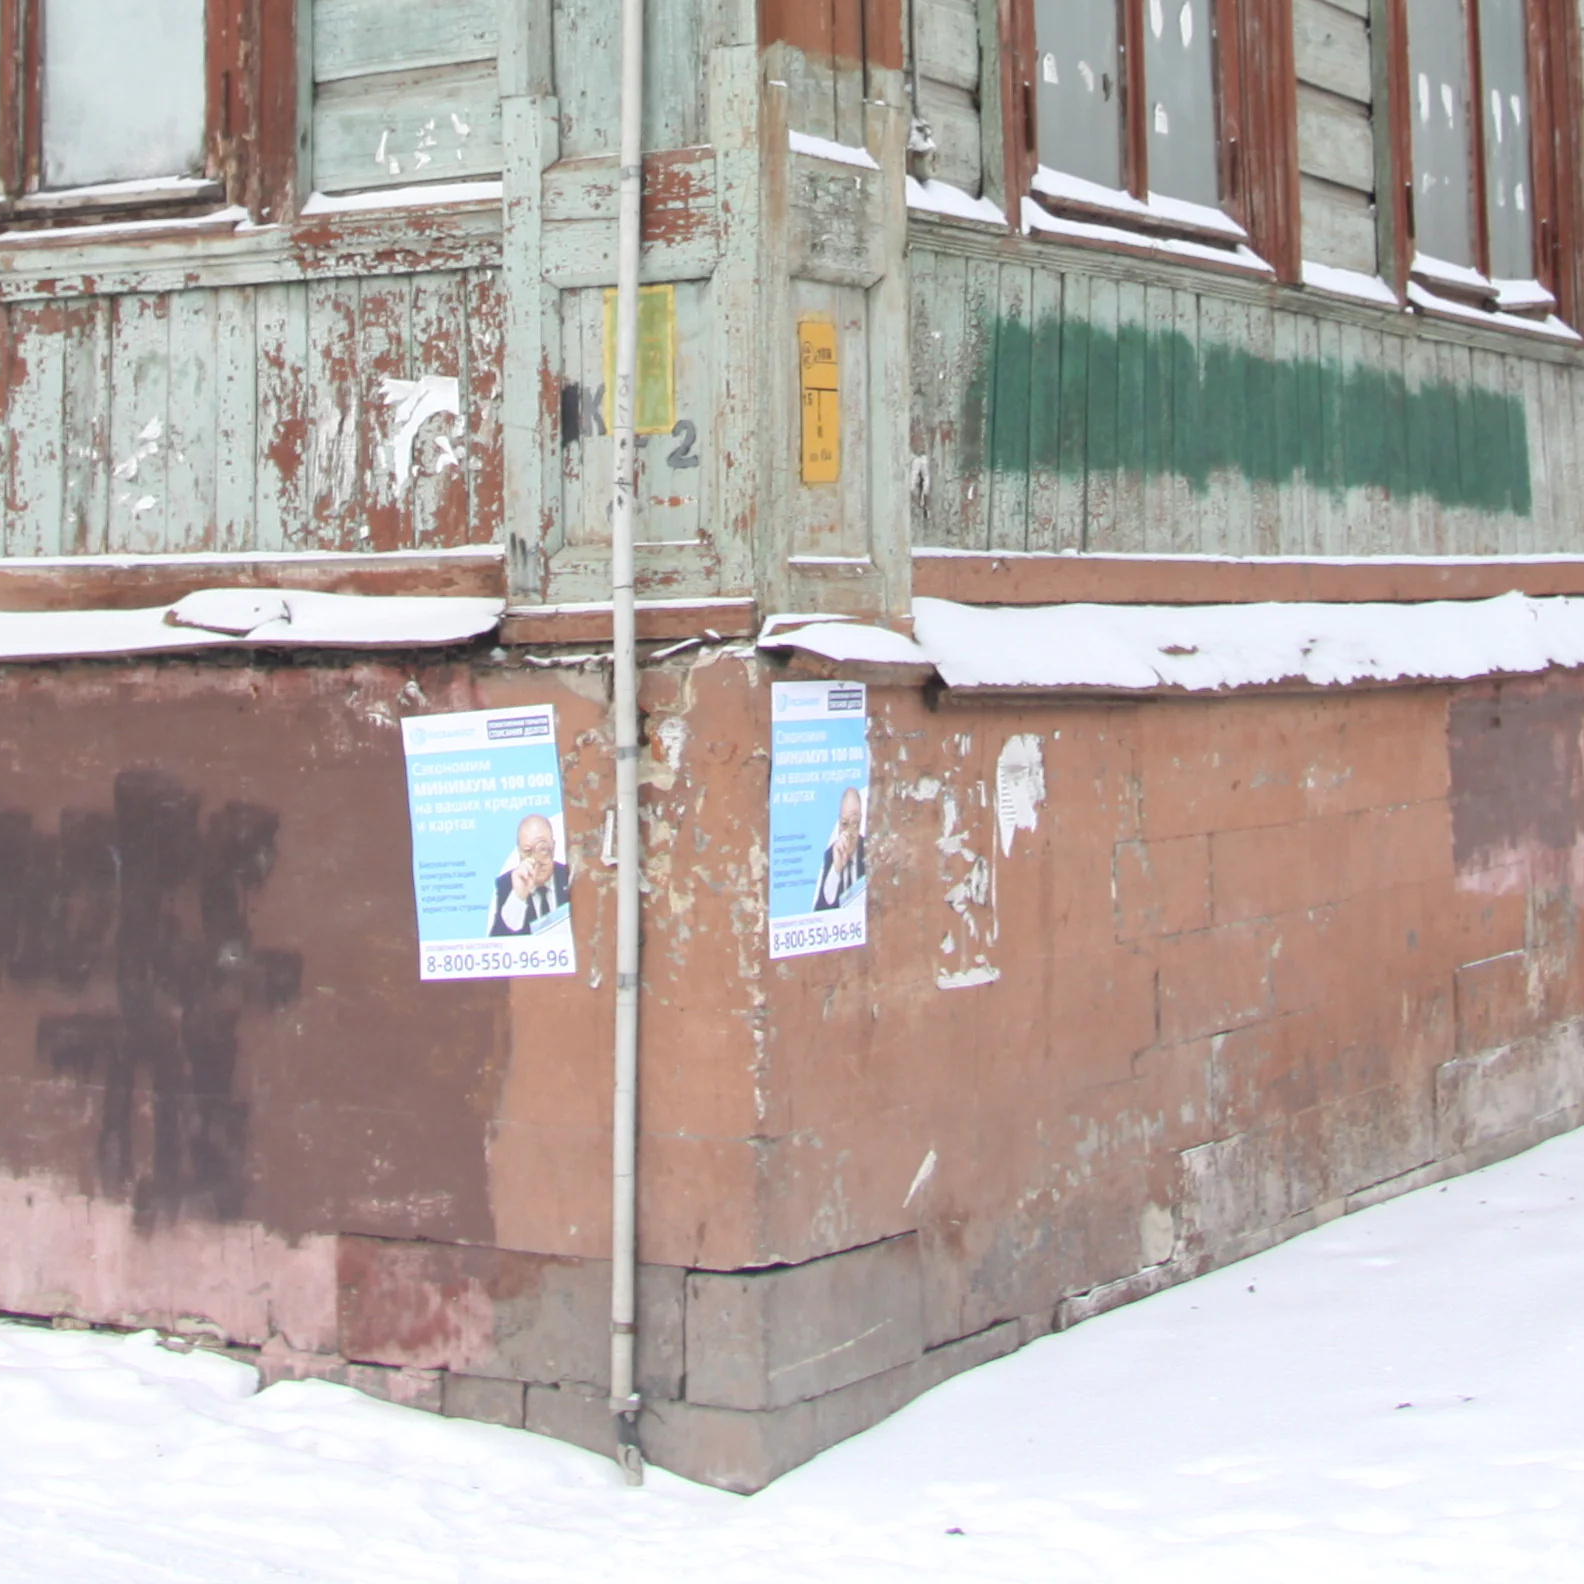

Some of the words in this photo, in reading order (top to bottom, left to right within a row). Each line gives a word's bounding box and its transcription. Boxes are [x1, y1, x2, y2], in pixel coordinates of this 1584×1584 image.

[412, 760, 490, 776] Сэкономим
[414, 777, 495, 796] МИНИМУМ
[500, 775, 523, 789] 100
[528, 773, 553, 787] 000
[415, 803, 431, 814] на
[435, 800, 480, 813] ваших
[485, 794, 550, 812] кредитах
[417, 823, 424, 832] и
[430, 818, 475, 834] картах
[773, 921, 862, 951] 8-800-550-96-96
[426, 949, 569, 973] 8-800-550-96-96
